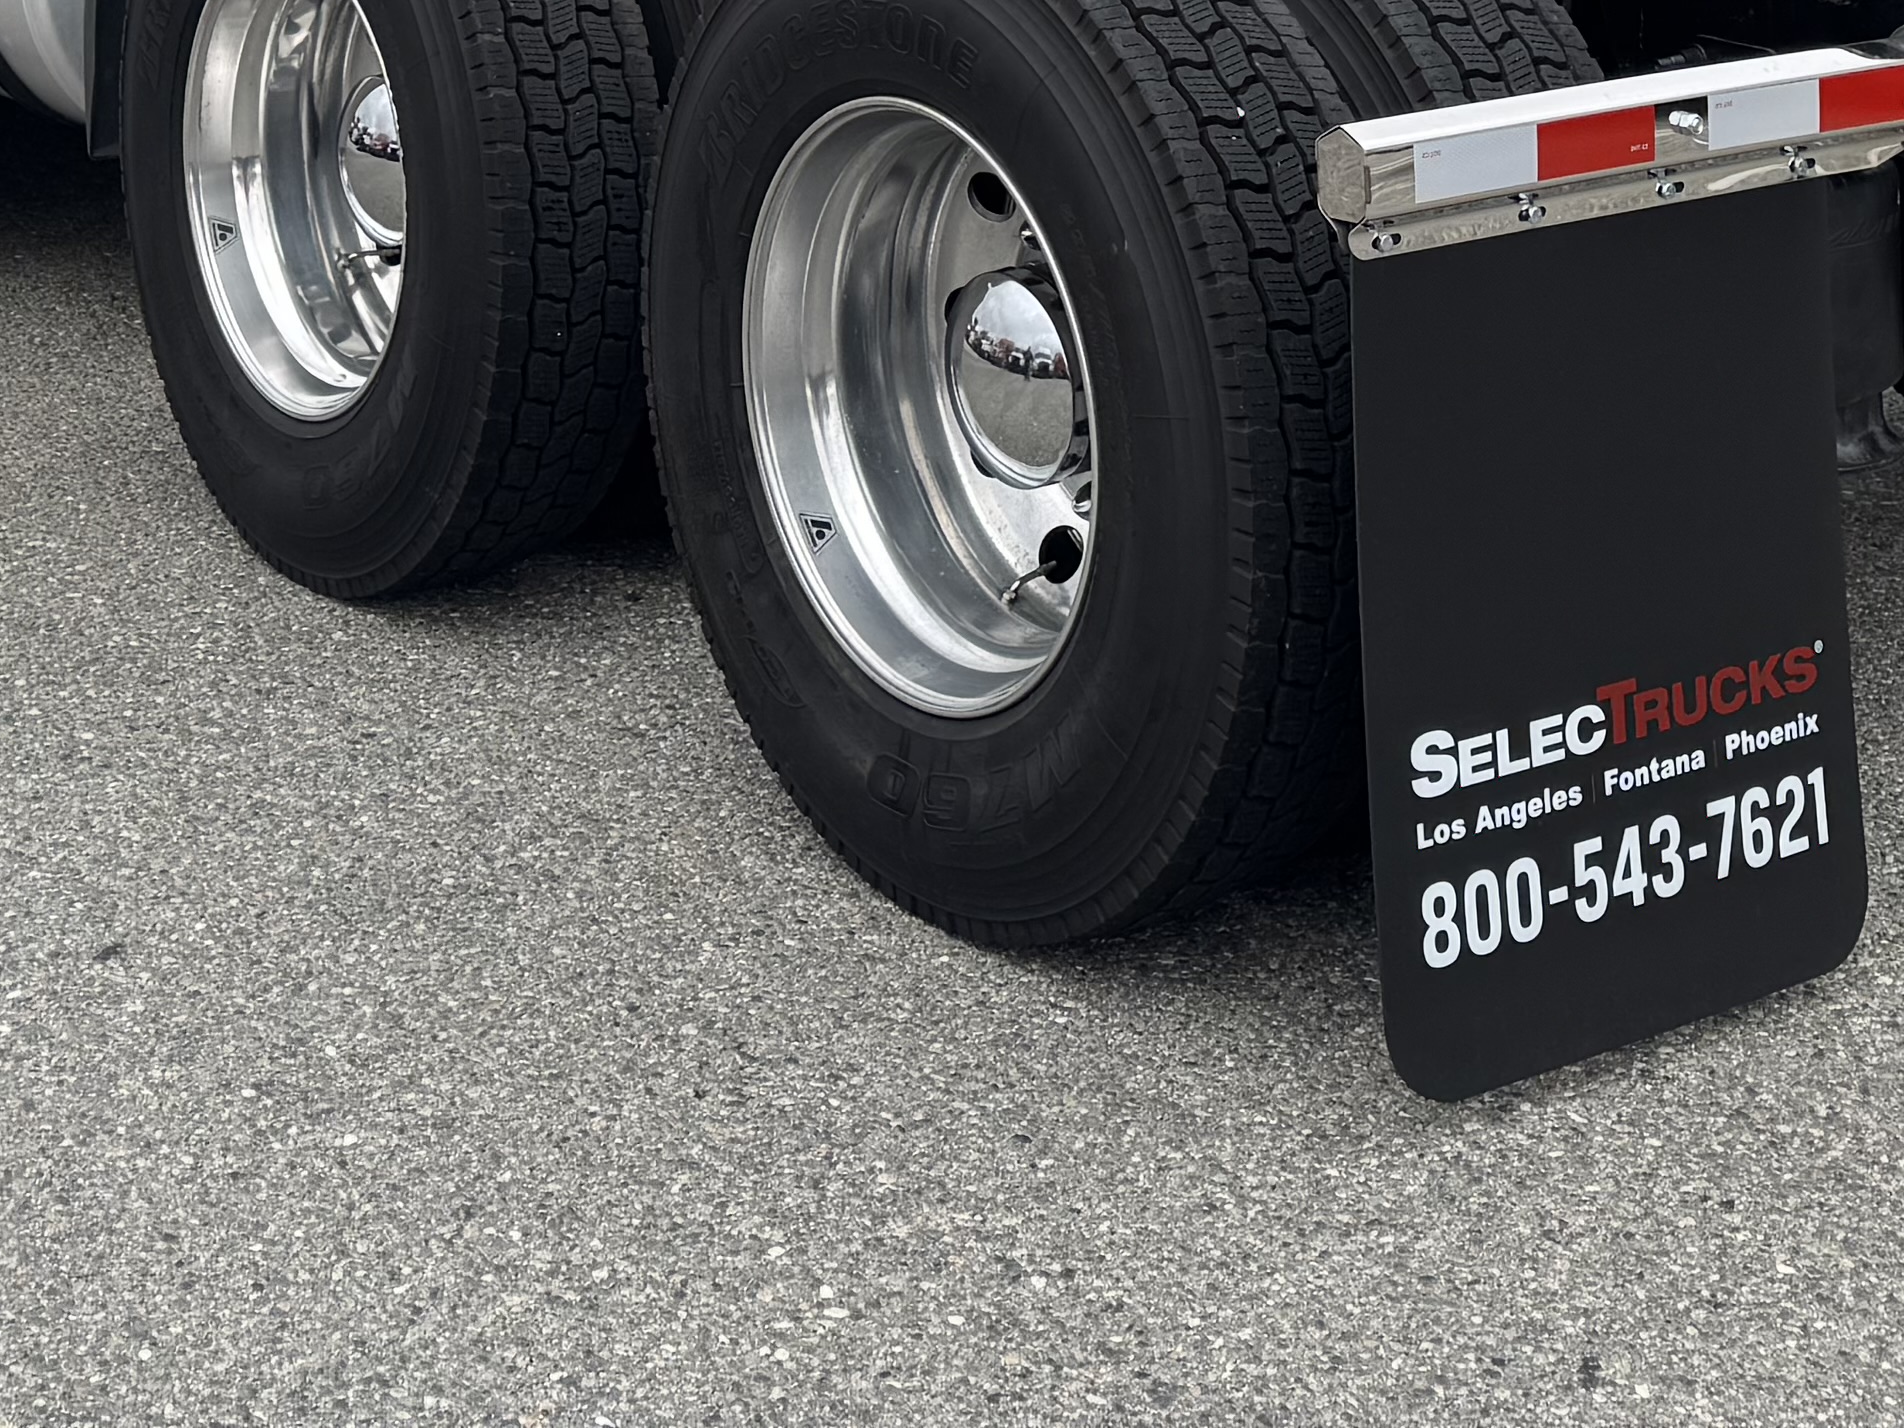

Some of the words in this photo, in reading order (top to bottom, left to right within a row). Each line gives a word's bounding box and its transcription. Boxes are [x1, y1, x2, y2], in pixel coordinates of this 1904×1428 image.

[867, 710, 1084, 832] M760
[1409, 645, 1820, 799] SELECTRUCKS
[1416, 816, 1467, 850] Los
[1474, 783, 1583, 835] Angeles
[1603, 747, 1706, 797] Fontana
[1724, 710, 1820, 761] Phoenix
[1420, 765, 1831, 969] 800-543-7621
